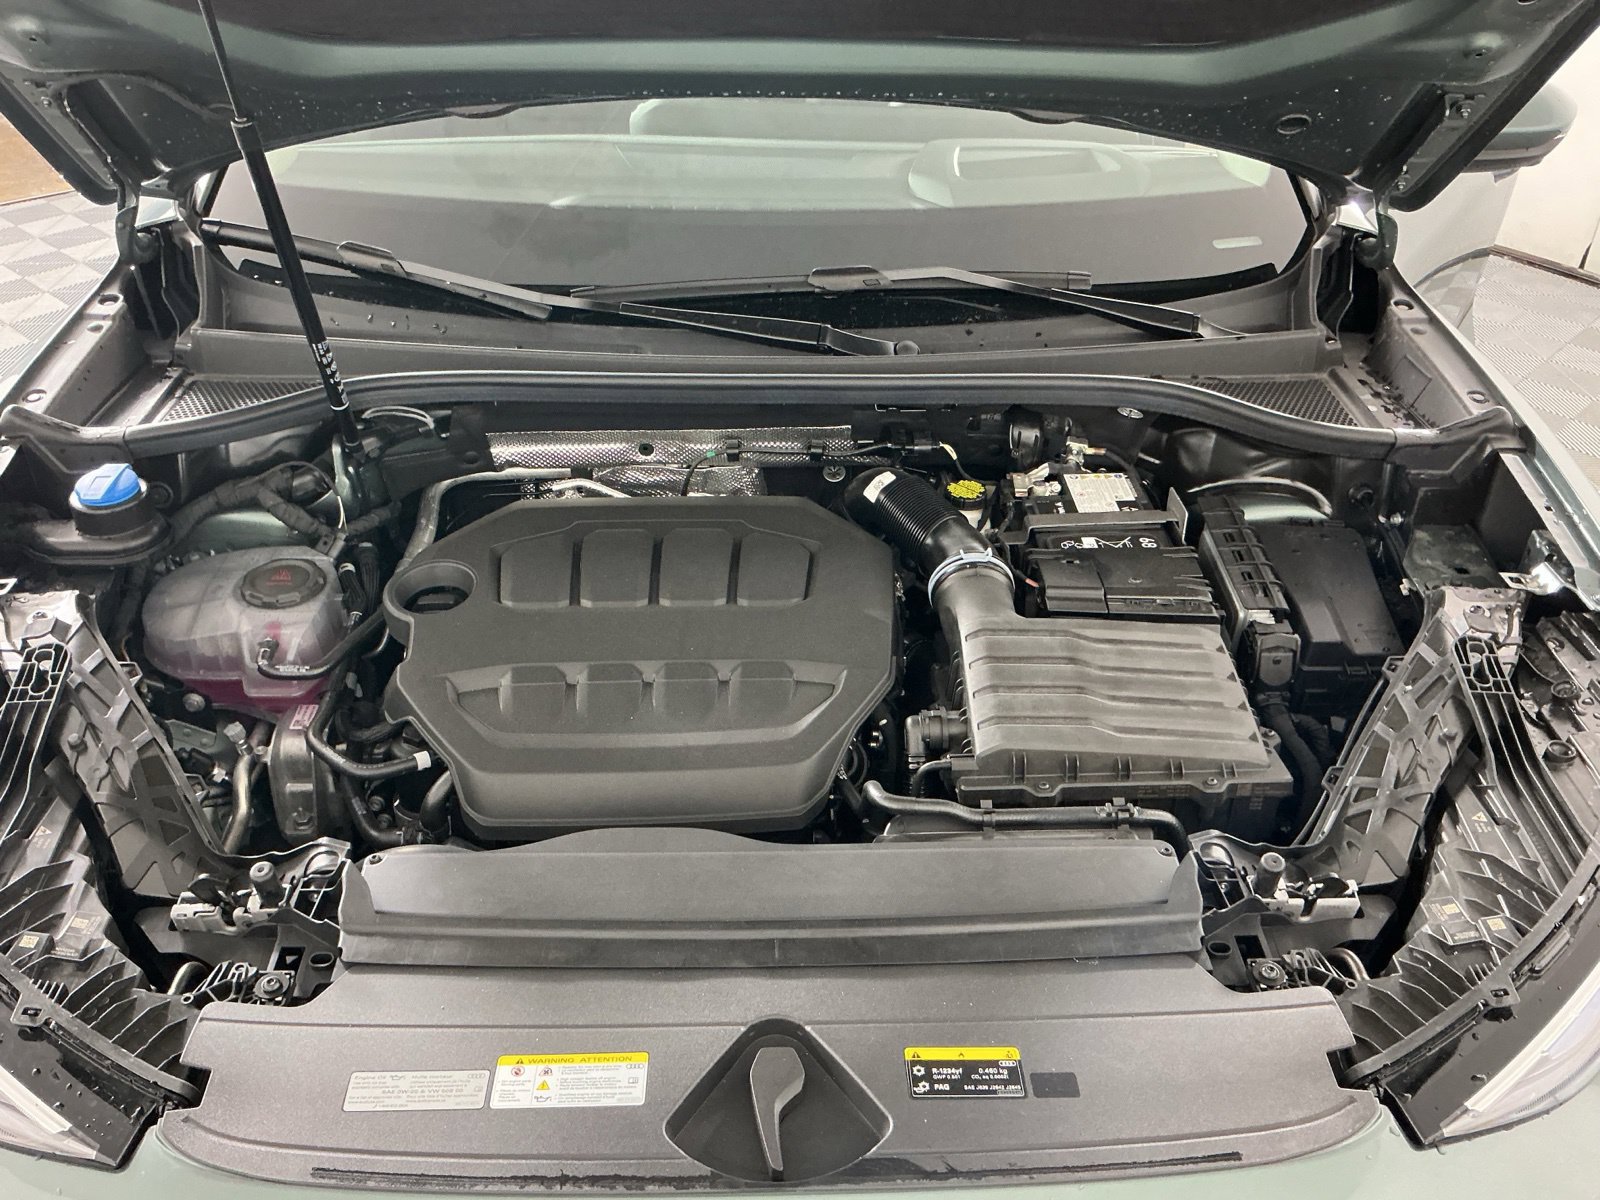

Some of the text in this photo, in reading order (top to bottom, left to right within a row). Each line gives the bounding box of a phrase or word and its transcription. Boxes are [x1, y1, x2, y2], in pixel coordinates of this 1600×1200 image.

[527, 1057, 575, 1065] WARNING
[998, 1066, 1008, 1075] kg
[933, 1083, 950, 1091] PAG
